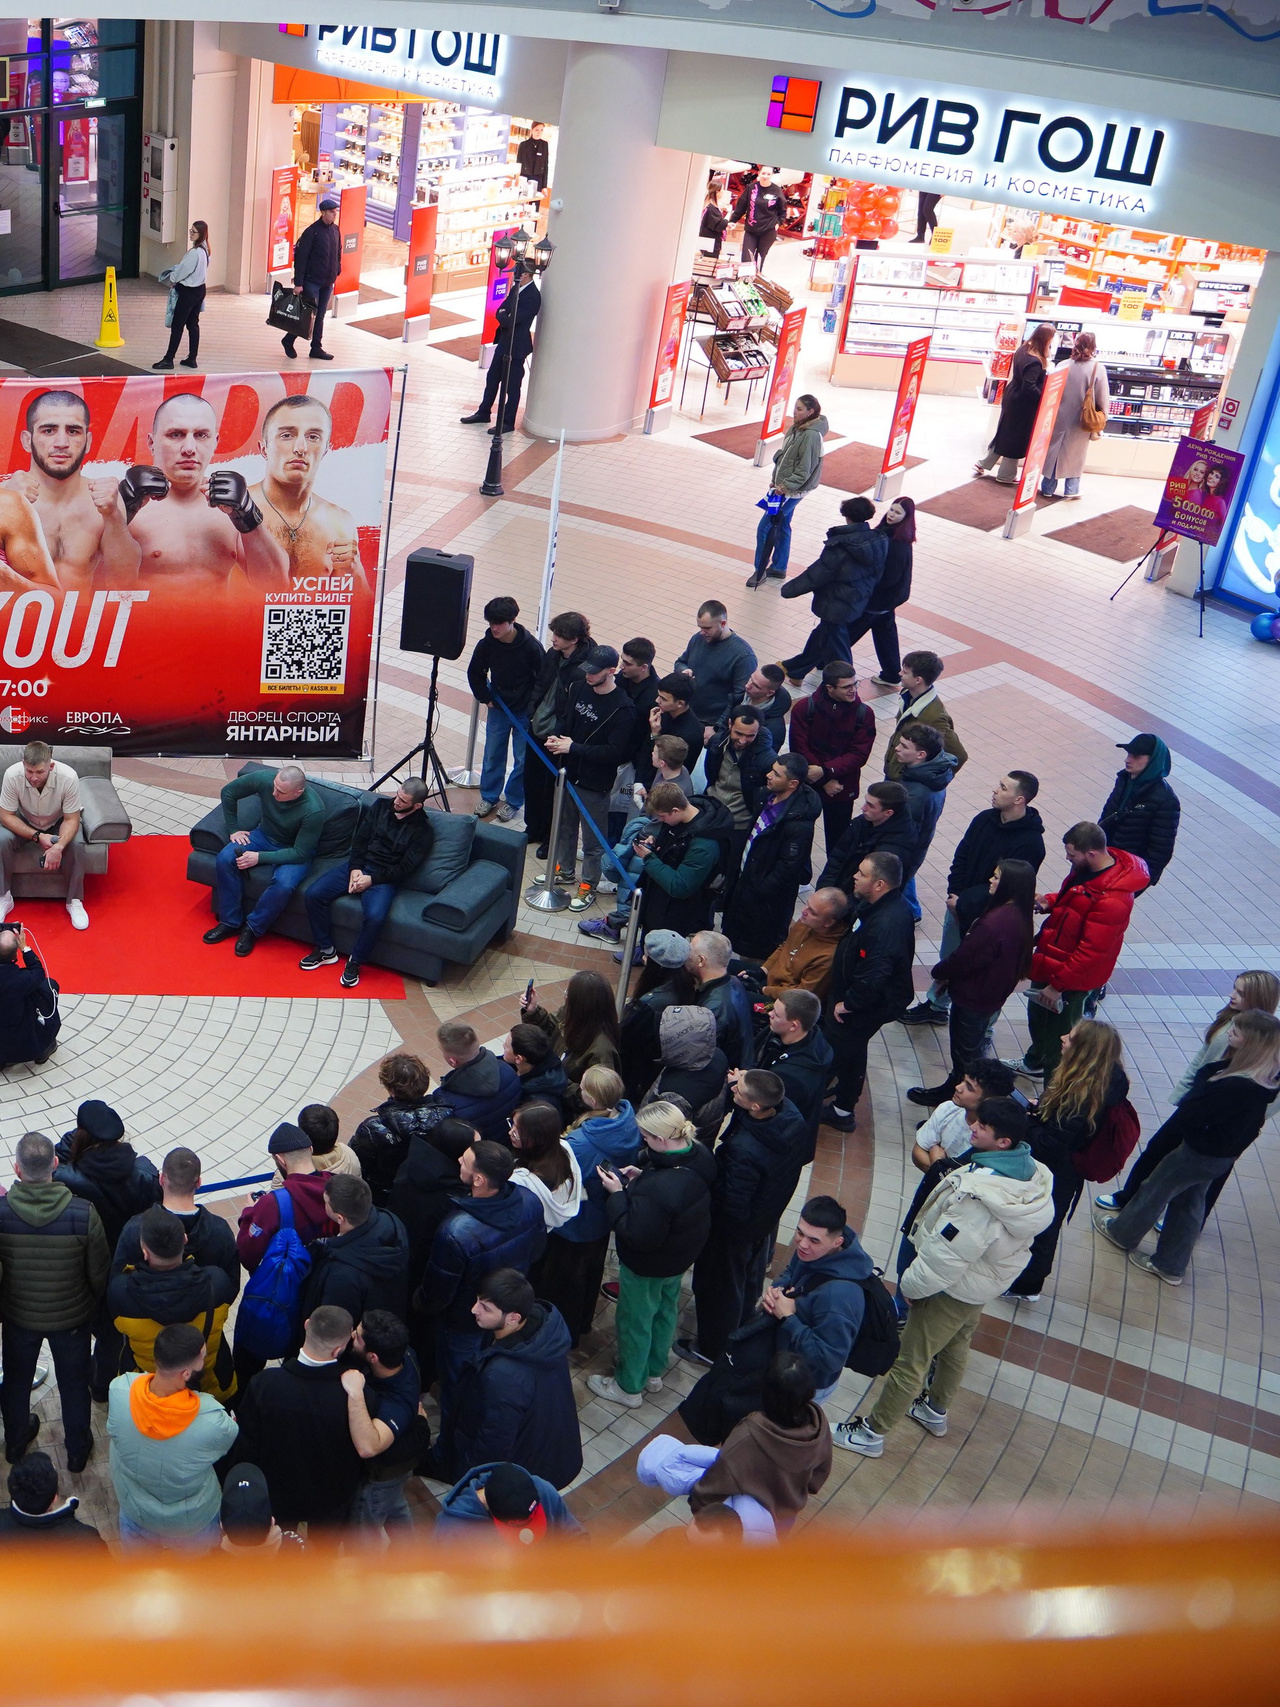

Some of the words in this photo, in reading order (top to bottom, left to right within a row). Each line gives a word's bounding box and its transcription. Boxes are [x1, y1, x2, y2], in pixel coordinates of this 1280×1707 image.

[316, 49, 397, 78] ПАРФЮМЕРИЯ
[403, 68, 412, 78] И
[417, 73, 495, 98] КОСМЕТИКА
[834, 86, 979, 155] РИВ
[993, 108, 1165, 187] ГОШ
[829, 149, 973, 183] ПАРФЮМЕРИЯ
[984, 174, 997, 188] И
[1007, 178, 1147, 213] КОСМЕТИКА
[1199, 282, 1244, 290] GIVENCHY
[1057, 323, 1080, 331] DIOR
[1170, 332, 1193, 340] DIOR
[1187, 443, 1203, 452] ДЕНЬ
[1204, 448, 1236, 462] РОЖДЕНИЯ
[1196, 452, 1208, 460] РИВ
[1170, 481, 1186, 490] РИВ
[1173, 496, 1182, 508] 5
[1182, 500, 1200, 515] 000
[1201, 506, 1215, 519] 000
[1175, 511, 1207, 526] БОНУСОВ
[1178, 521, 1205, 532] ПОДАРКИ
[292, 574, 354, 591] УСПЕЙ
[265, 593, 312, 603] КУПИТЬ
[315, 593, 353, 603] БИЛЕТ
[66, 711, 123, 724] ЕВРОПА
[228, 711, 283, 723] ДВОРЕЦ
[287, 712, 341, 723] СПОРТА
[226, 723, 340, 742] ЯНТАРНЫЙ
